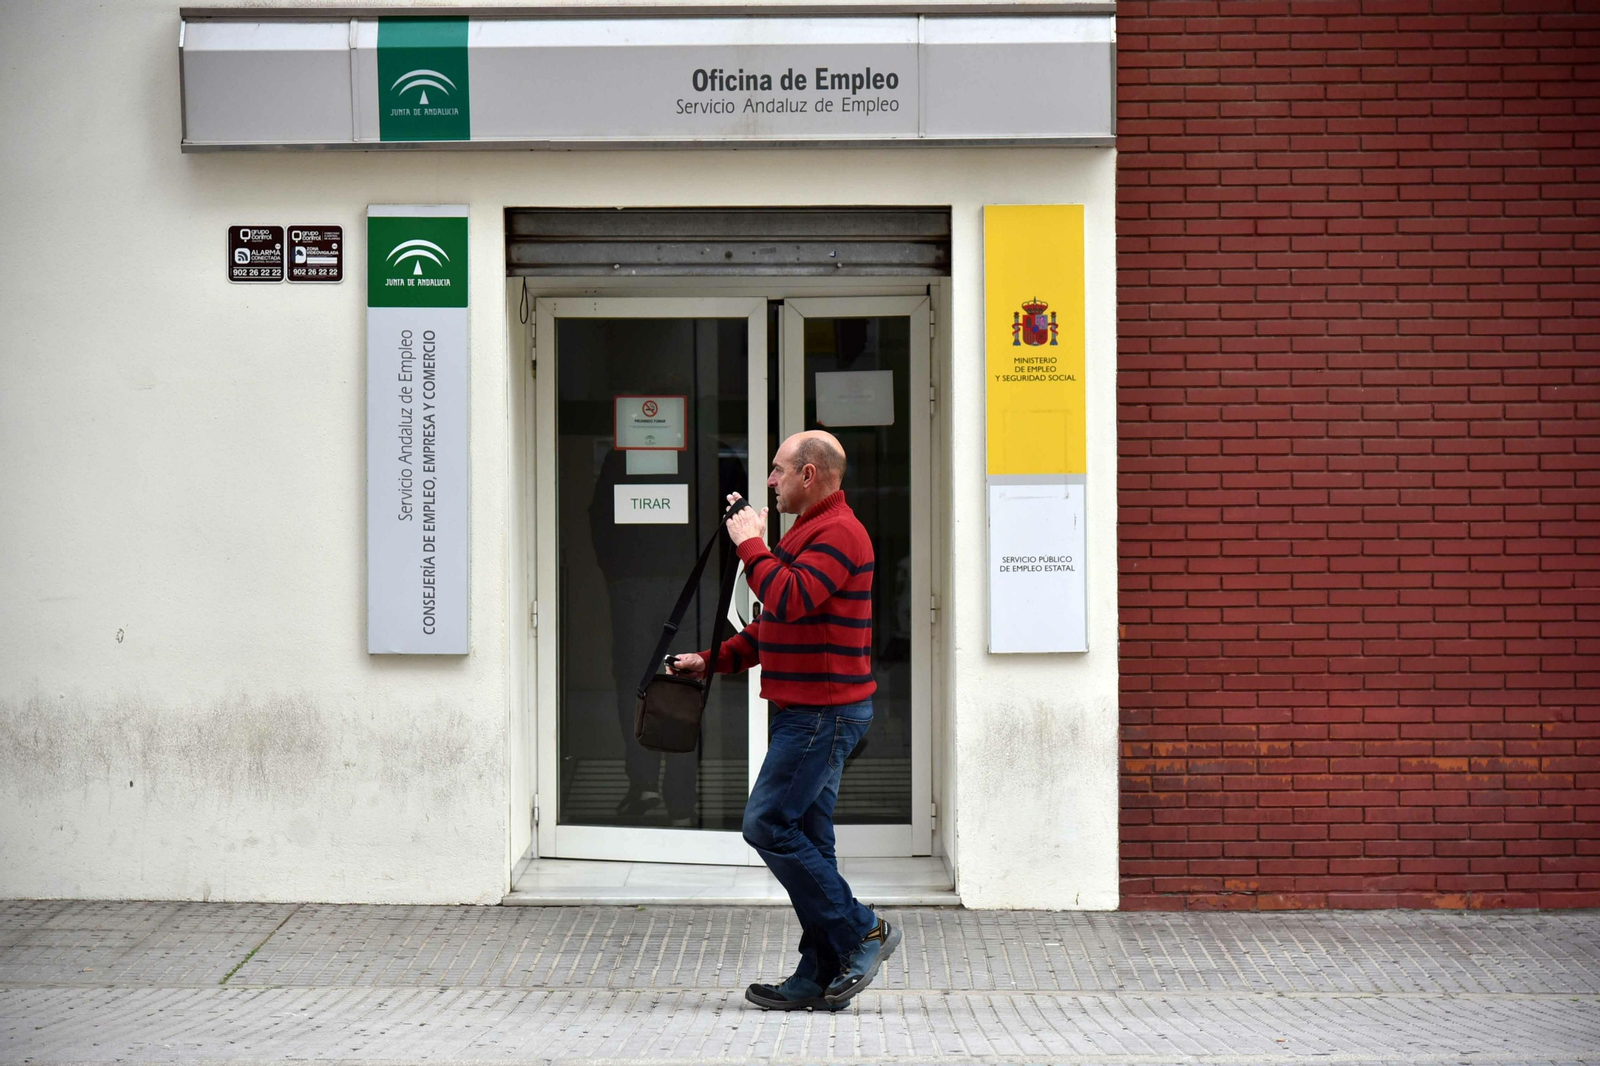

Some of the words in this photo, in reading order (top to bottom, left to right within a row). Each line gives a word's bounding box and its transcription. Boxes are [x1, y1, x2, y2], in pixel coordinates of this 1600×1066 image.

[692, 68, 772, 92] Oficina
[780, 68, 807, 91] de
[815, 67, 899, 95] Empleo
[390, 108, 410, 116] JUNTA
[413, 108, 421, 116] DE
[676, 98, 735, 114] Servicio
[743, 98, 807, 113] Andaluz
[815, 97, 833, 113] de
[841, 97, 899, 116] Empleo
[385, 278, 405, 286] JUNTA
[407, 278, 415, 286] DE
[398, 329, 416, 382] Empleo
[423, 330, 435, 400] COMERCIO
[398, 386, 413, 404] de
[423, 403, 435, 411] Y
[398, 407, 413, 465] Andaluz
[423, 414, 435, 473] EMPRESA
[398, 468, 413, 521] Servicio
[423, 477, 437, 531] EMPLEO,
[630, 498, 671, 510] TIRAR
[423, 535, 435, 552] DE
[999, 565, 1010, 573] DE
[1044, 564, 1076, 572] ESTATAL
[1038, 555, 1073, 563] PÚBLICO
[420, 556, 435, 635] CONSEJERÍA
